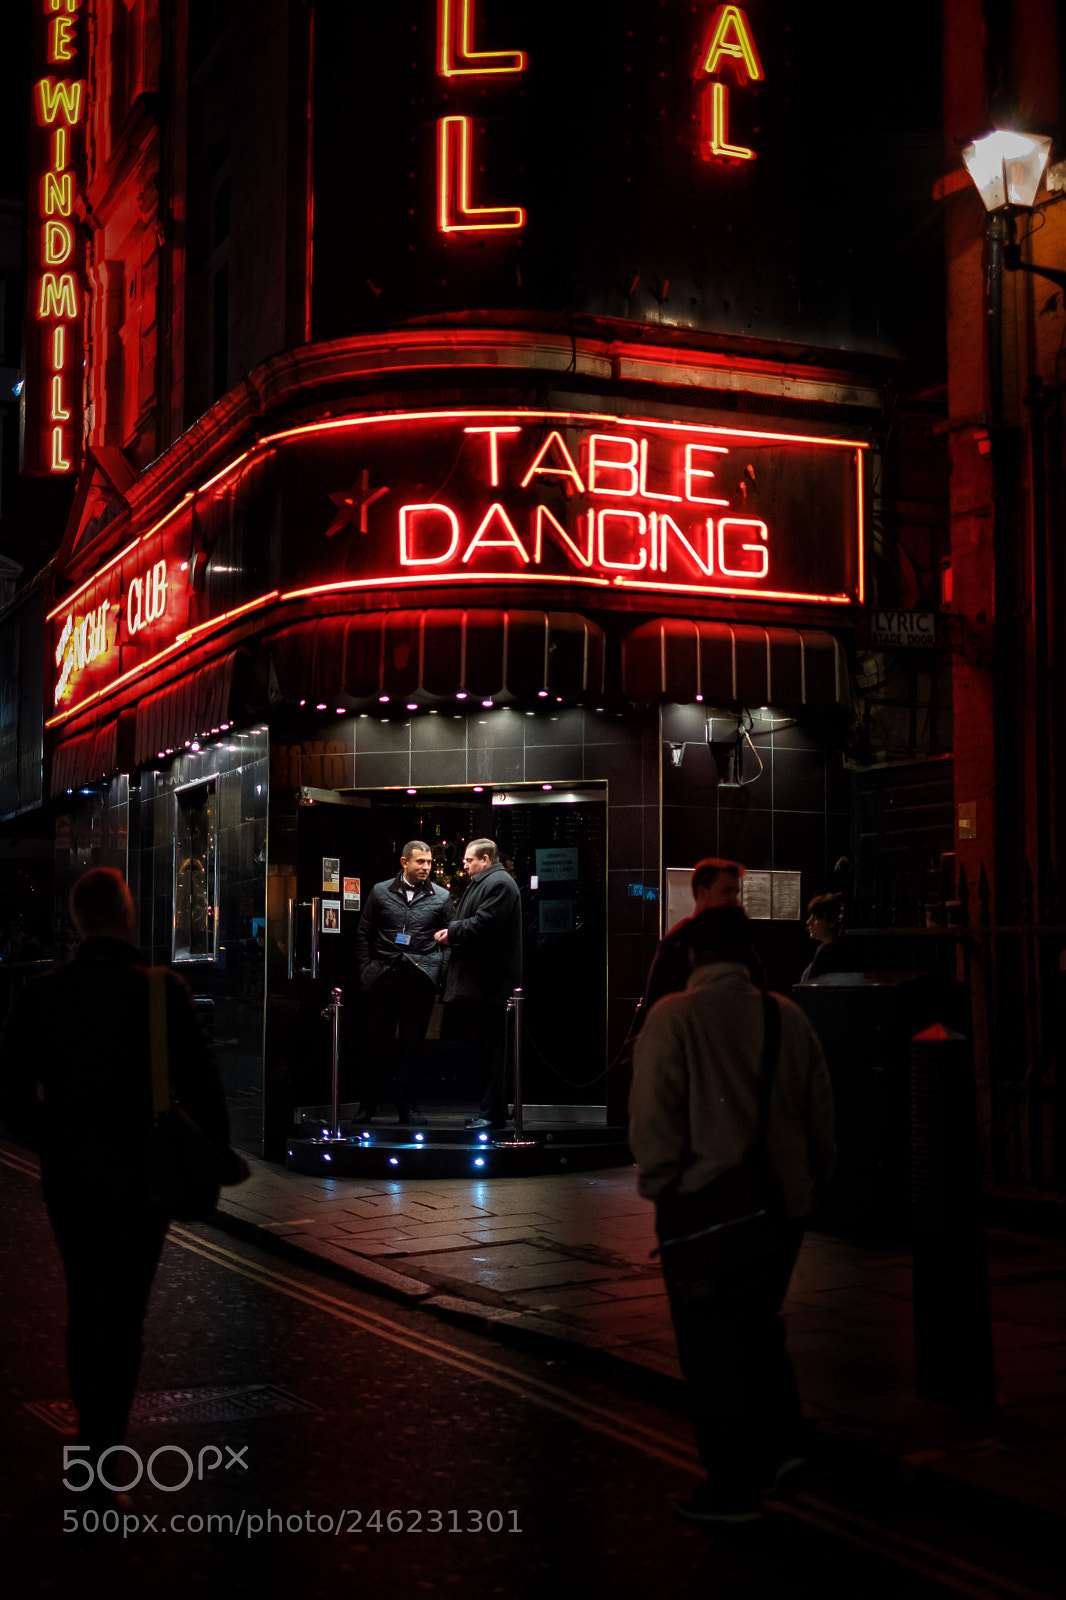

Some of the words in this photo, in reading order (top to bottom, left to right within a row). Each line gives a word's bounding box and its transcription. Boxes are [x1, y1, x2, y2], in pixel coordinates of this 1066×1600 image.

[39, 78, 81, 471] WINDMILL
[462, 425, 731, 507] TABLE
[398, 502, 769, 579] DANCING
[127, 559, 169, 635] CLUB
[876, 611, 930, 632] LYRIC
[873, 633, 903, 645] STAGE
[907, 634, 933, 645] DOOR
